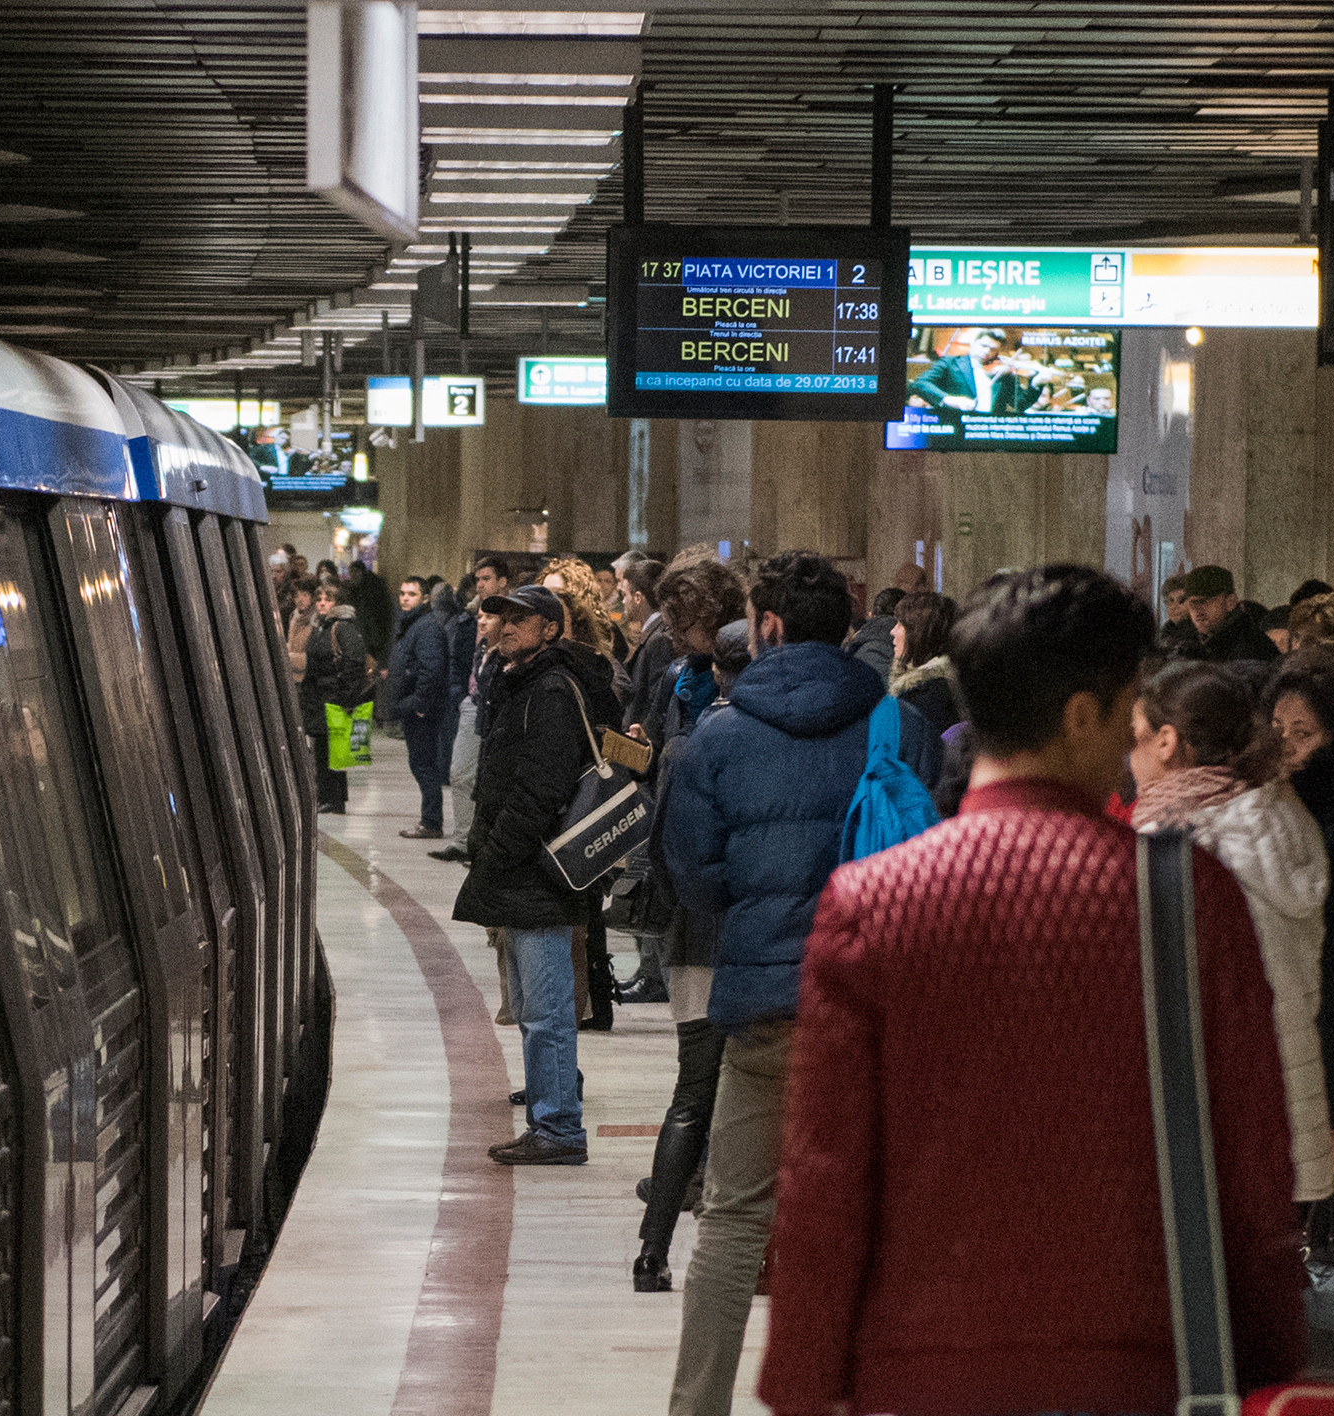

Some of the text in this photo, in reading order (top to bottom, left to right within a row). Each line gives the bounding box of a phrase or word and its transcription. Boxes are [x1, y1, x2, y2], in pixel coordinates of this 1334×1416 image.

[641, 262, 681, 278] 17 37
[684, 264, 834, 280] PIATA VICTORIEI 1
[851, 264, 866, 284] 2
[934, 266, 944, 280] B
[957, 260, 1041, 291] IEȘIRE
[682, 297, 790, 319] BERCENI
[836, 302, 879, 320] 17:38
[926, 294, 978, 310] Lascar
[980, 294, 1046, 314] Catargiu
[1021, 336, 1062, 346] REMUS
[681, 341, 789, 362] BERCENI
[835, 346, 876, 364] 17:41
[646, 376, 662, 386] ca
[725, 377, 741, 387] cu
[745, 375, 772, 387] data
[775, 376, 791, 388] de
[794, 376, 866, 389] 29.07.2013
[453, 395, 469, 416] 2
[584, 802, 647, 859] CERAGEM
